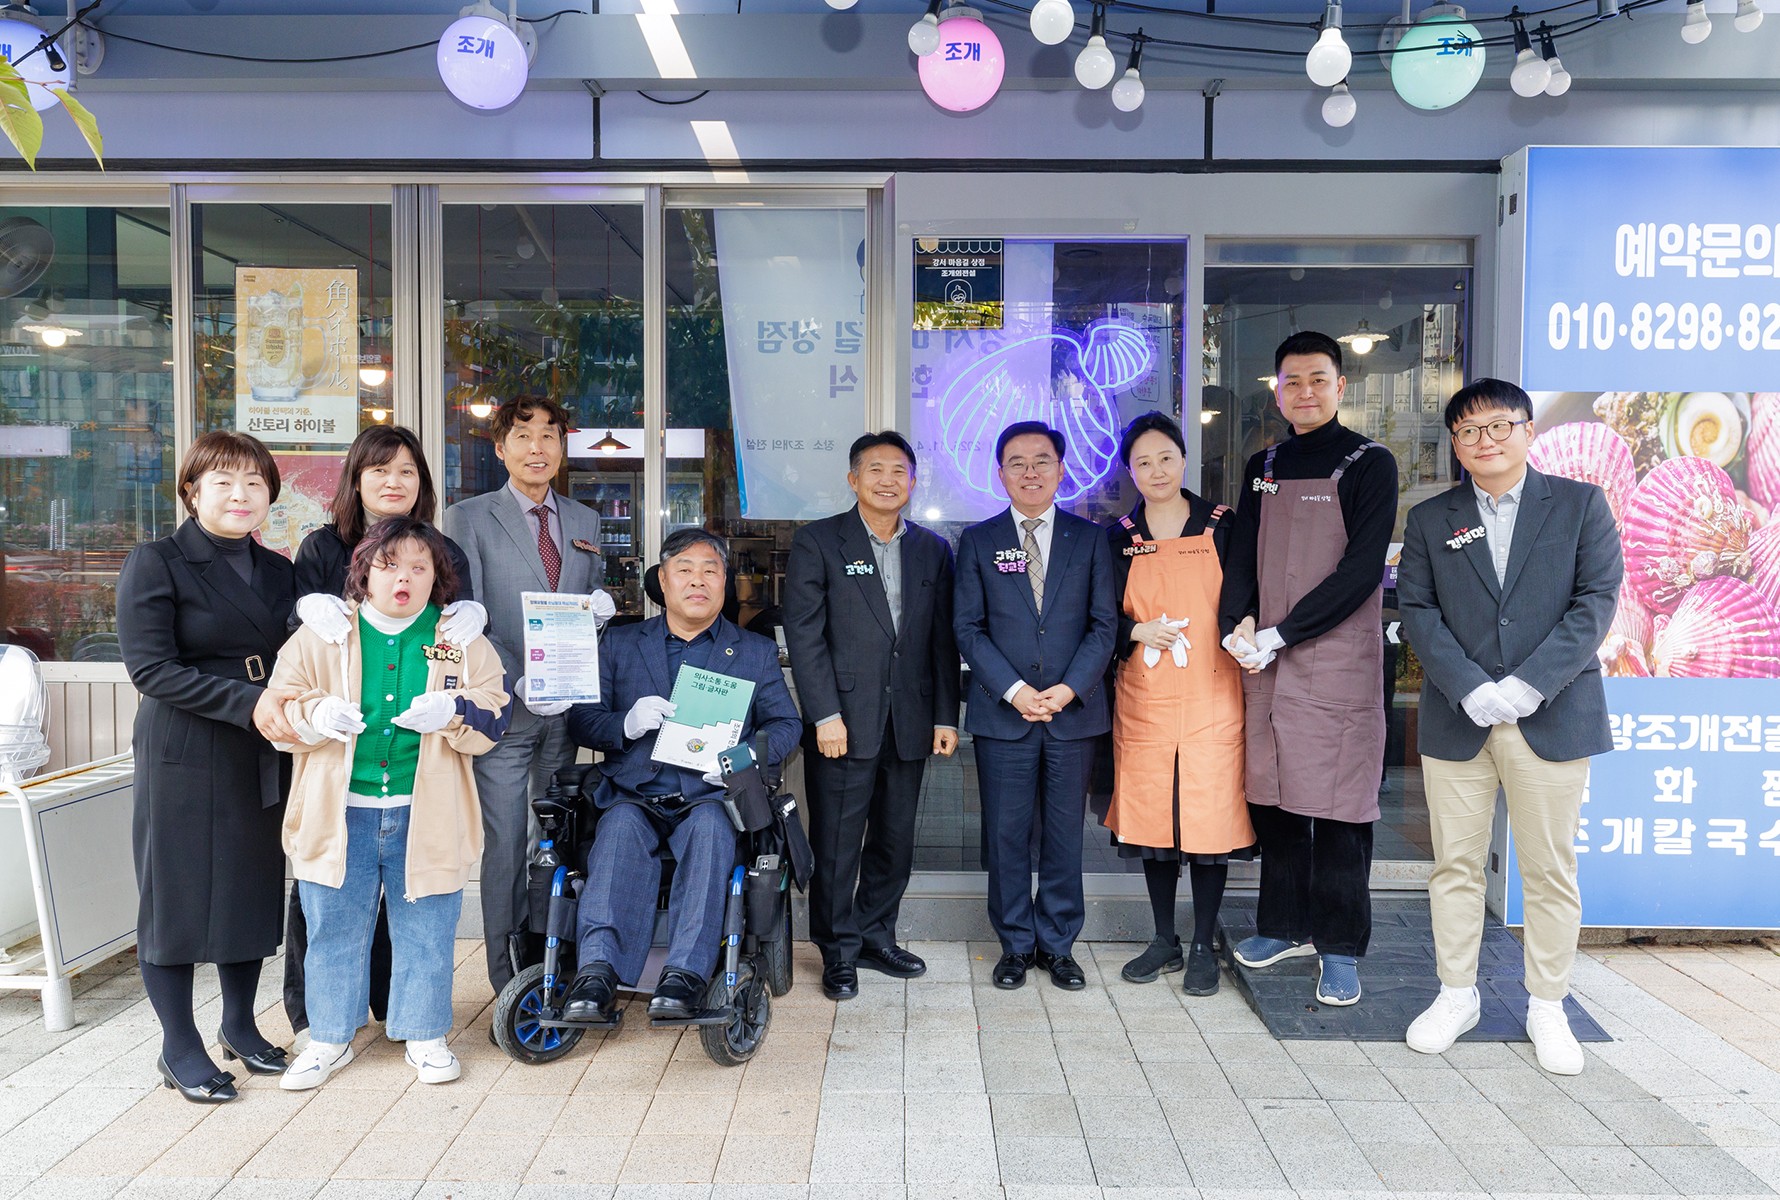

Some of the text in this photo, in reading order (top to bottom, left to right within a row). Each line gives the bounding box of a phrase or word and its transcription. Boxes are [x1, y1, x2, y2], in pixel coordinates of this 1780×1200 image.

[457, 35, 495, 59] 조개
[945, 42, 980, 62] 조개
[1615, 222, 1780, 278] 예약문의
[932, 258, 986, 267] 강서 마음길 상점
[247, 417, 336, 434] 산토리 하이볼
[694, 672, 738, 690] 의사소통 도움
